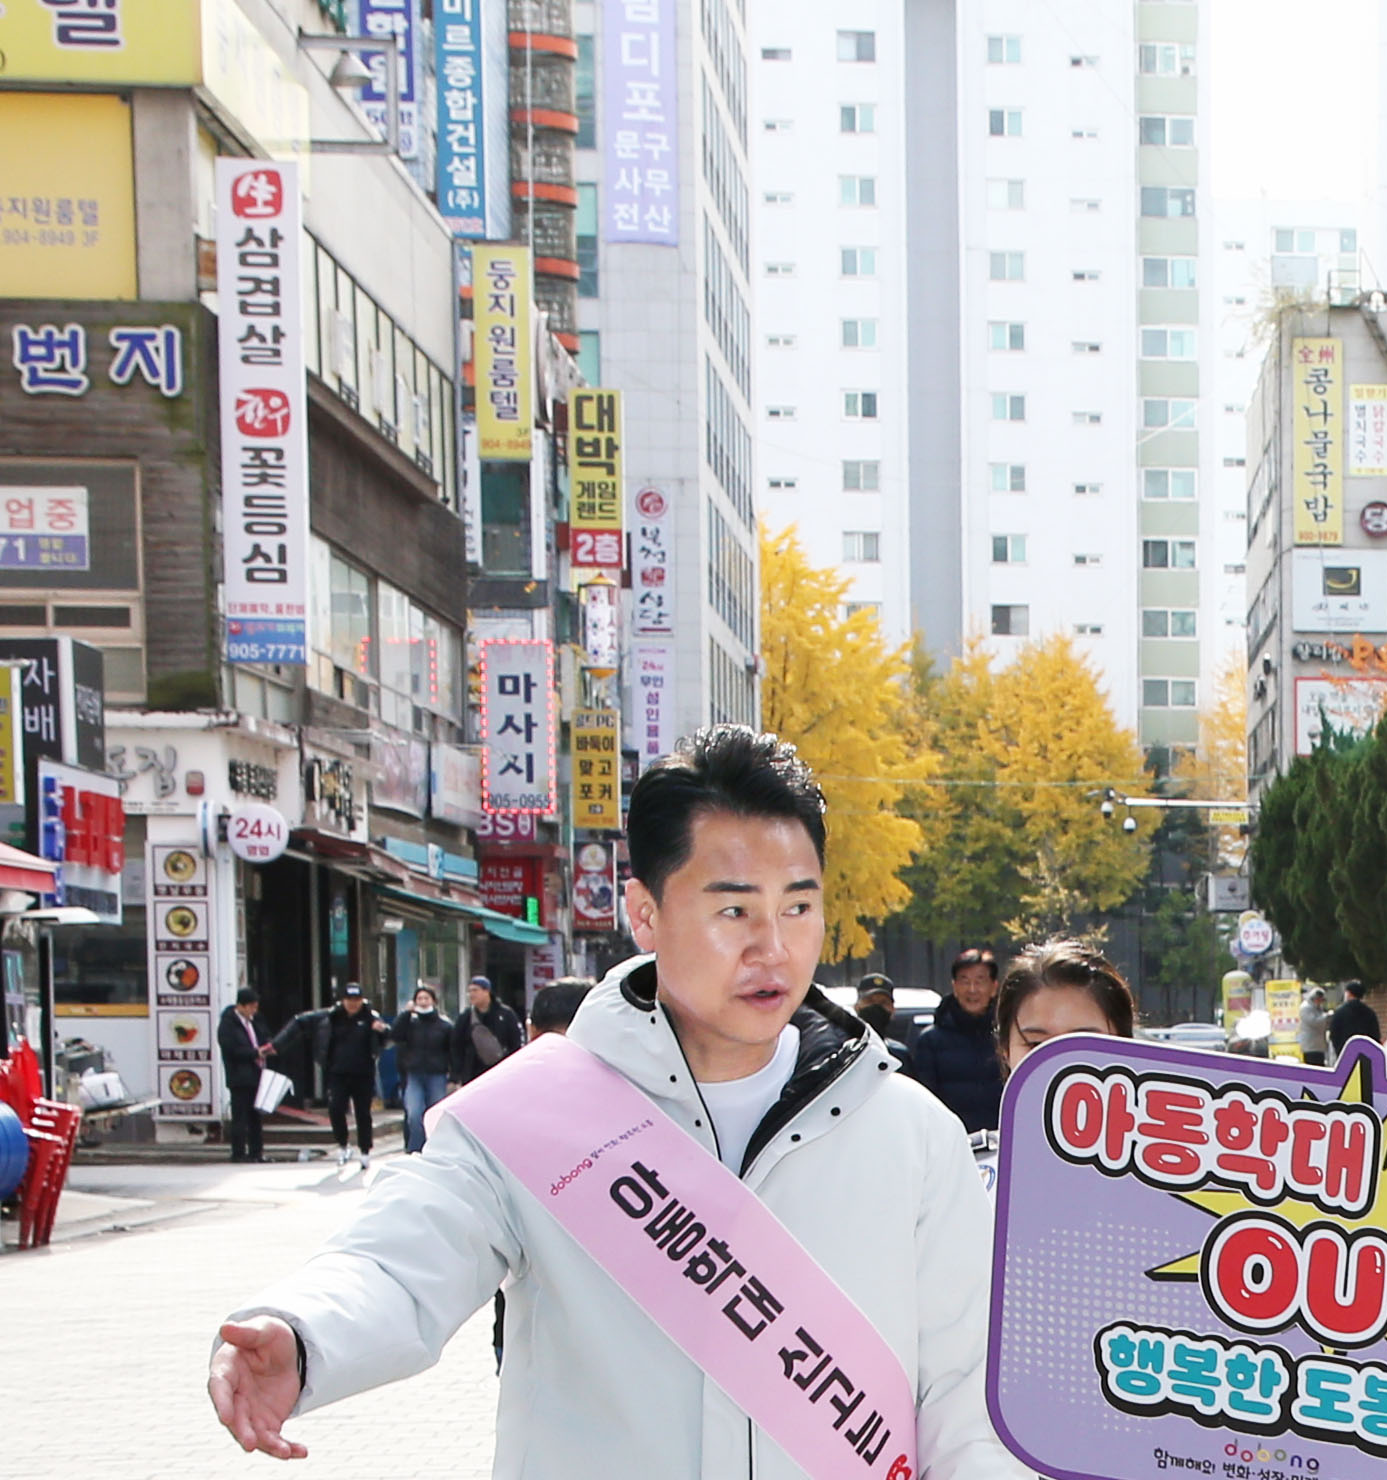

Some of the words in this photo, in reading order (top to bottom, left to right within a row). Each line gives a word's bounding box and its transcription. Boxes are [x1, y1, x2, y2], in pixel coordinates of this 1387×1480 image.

[235, 227, 286, 366] 삼겹살
[14, 323, 182, 396] 번지
[486, 326, 520, 421] 원룸텔
[574, 393, 619, 476] 대박
[576, 480, 617, 500] 게임
[240, 446, 288, 584] 꽃등심
[576, 501, 617, 521] 랜드
[576, 533, 619, 563] 2층
[575, 736, 615, 752] 바둑이
[579, 783, 612, 800] 포커
[235, 816, 282, 841] 24시
[1057, 1079, 1368, 1205] 아동학대
[550, 1158, 593, 1196] dobong
[609, 1160, 785, 1342] 아동학대
[777, 1327, 891, 1466] 신고는
[1106, 1332, 1283, 1426] 행복한
[1153, 1446, 1216, 1475] 함께해요!
[1224, 1438, 1320, 1475] dobong
